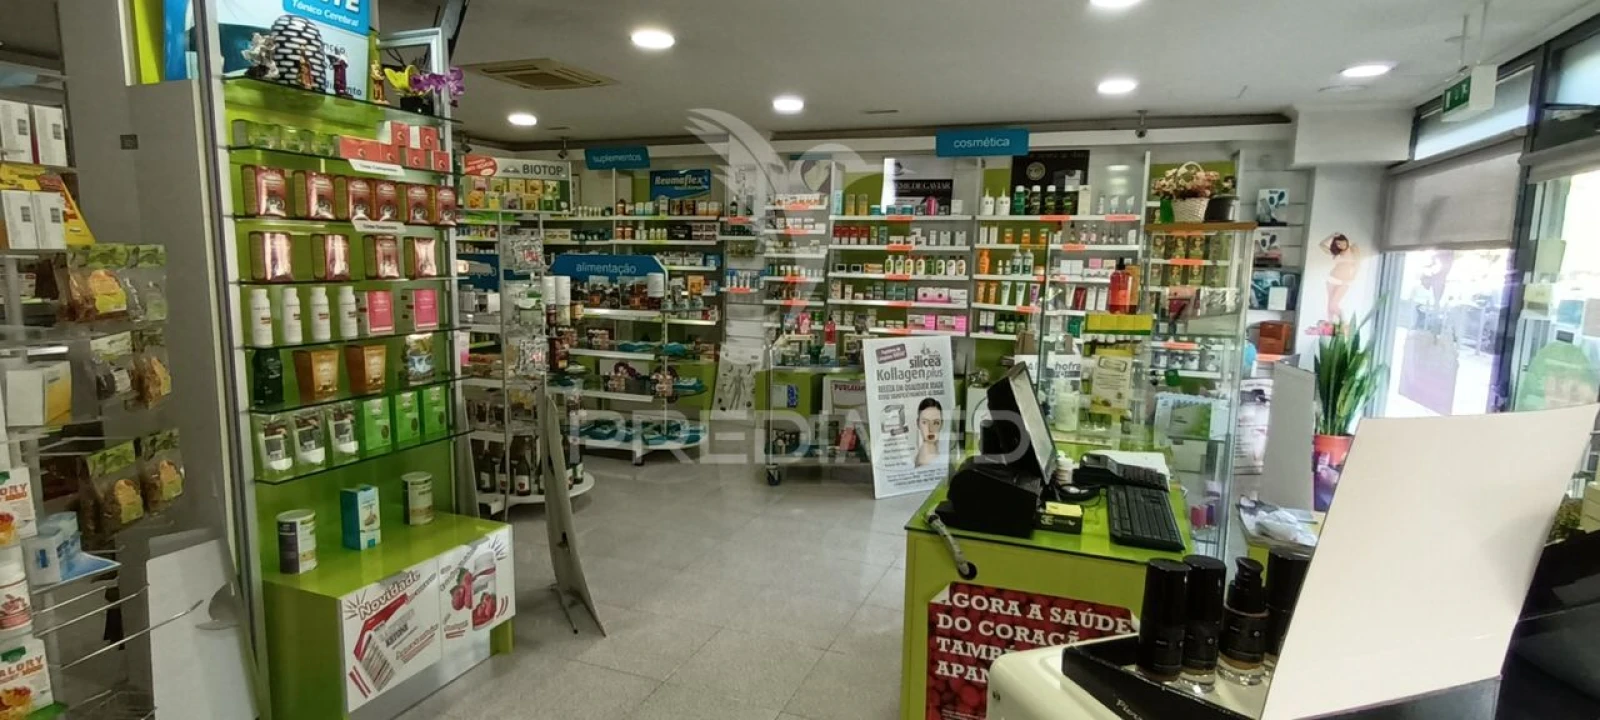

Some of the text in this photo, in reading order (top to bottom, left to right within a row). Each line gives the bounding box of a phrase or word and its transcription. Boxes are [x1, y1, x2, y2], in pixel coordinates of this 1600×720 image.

[324, 9, 360, 27] Cerebral
[953, 136, 1011, 149] cosmética
[592, 153, 643, 164] suplementos
[522, 164, 564, 176] BIOTOP
[575, 262, 638, 275] alimentação
[909, 354, 942, 369] silicea
[876, 367, 926, 383] Kollagen
[936, 613, 972, 632] DO
[1026, 603, 1044, 621] A
[1050, 608, 1132, 634] SAÚDE
